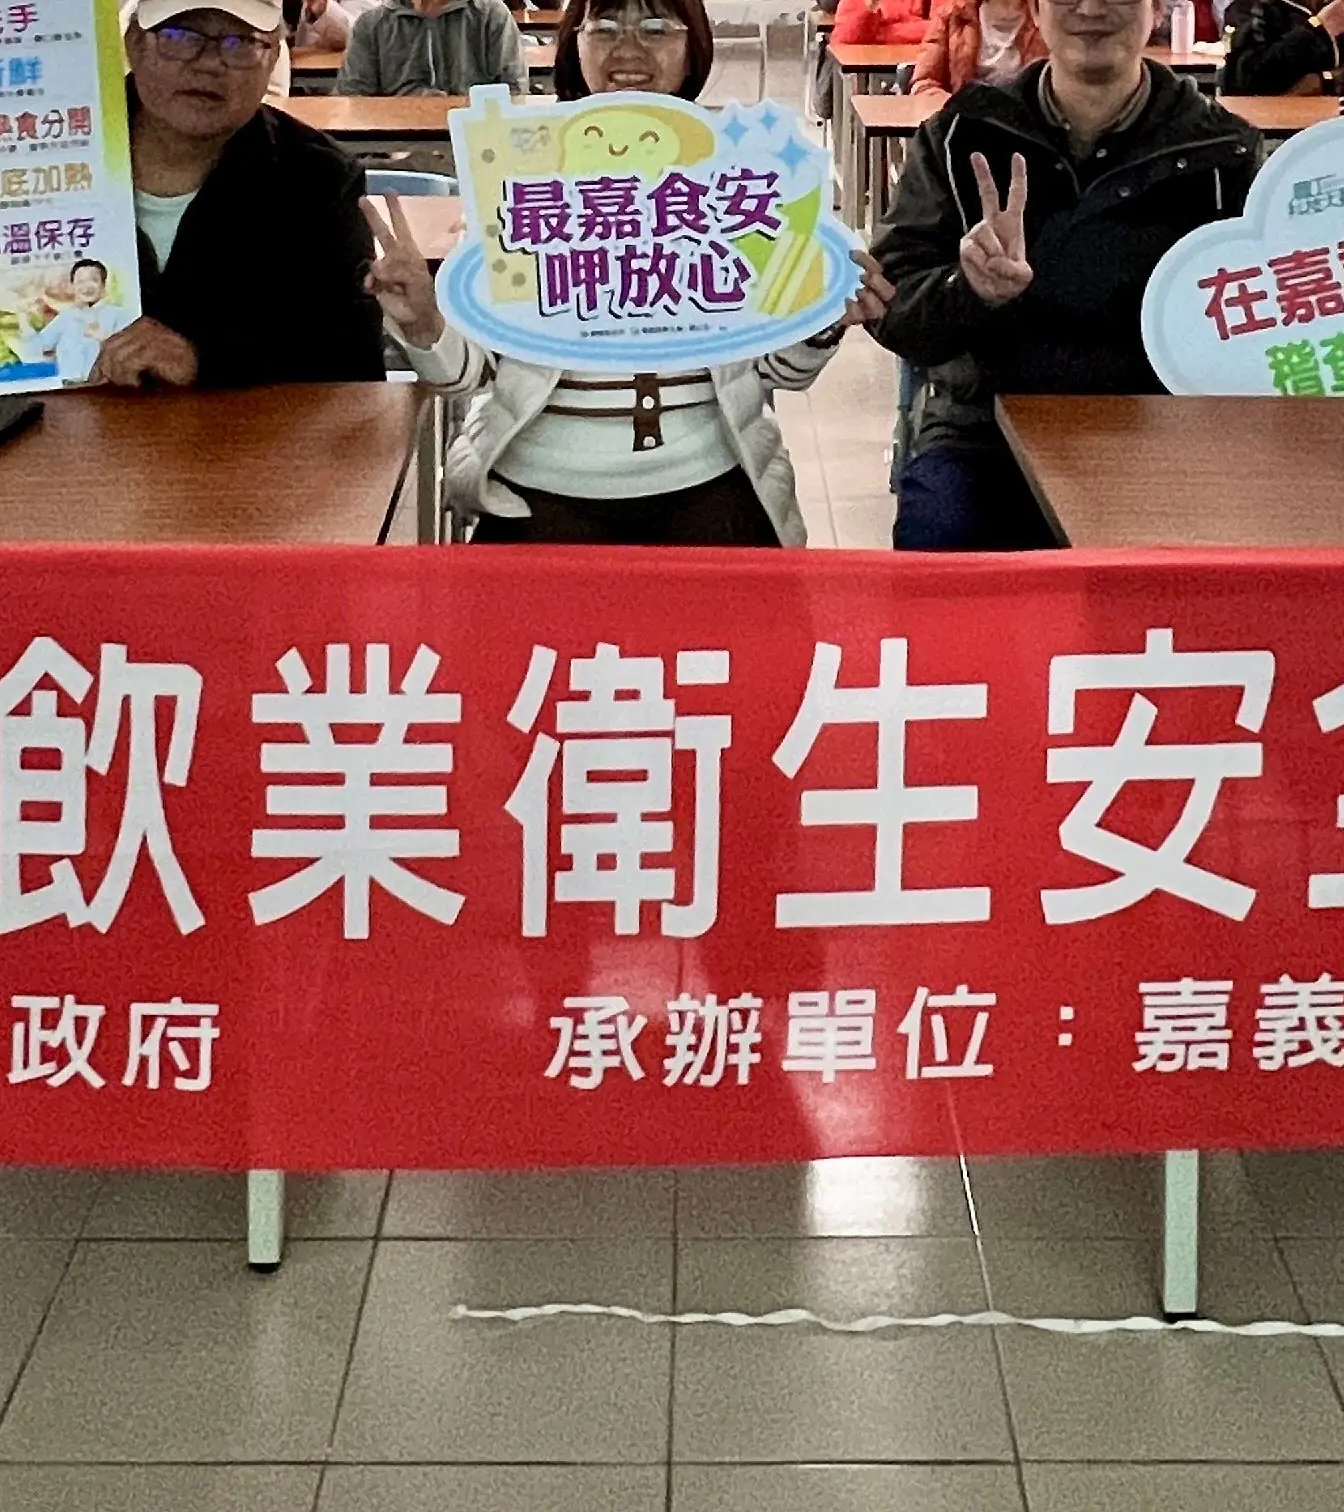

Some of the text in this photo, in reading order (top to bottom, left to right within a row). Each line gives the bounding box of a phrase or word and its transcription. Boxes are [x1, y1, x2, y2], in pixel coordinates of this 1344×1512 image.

[509, 168, 782, 246] 最嘉食安
[545, 241, 752, 311] 呷放心
